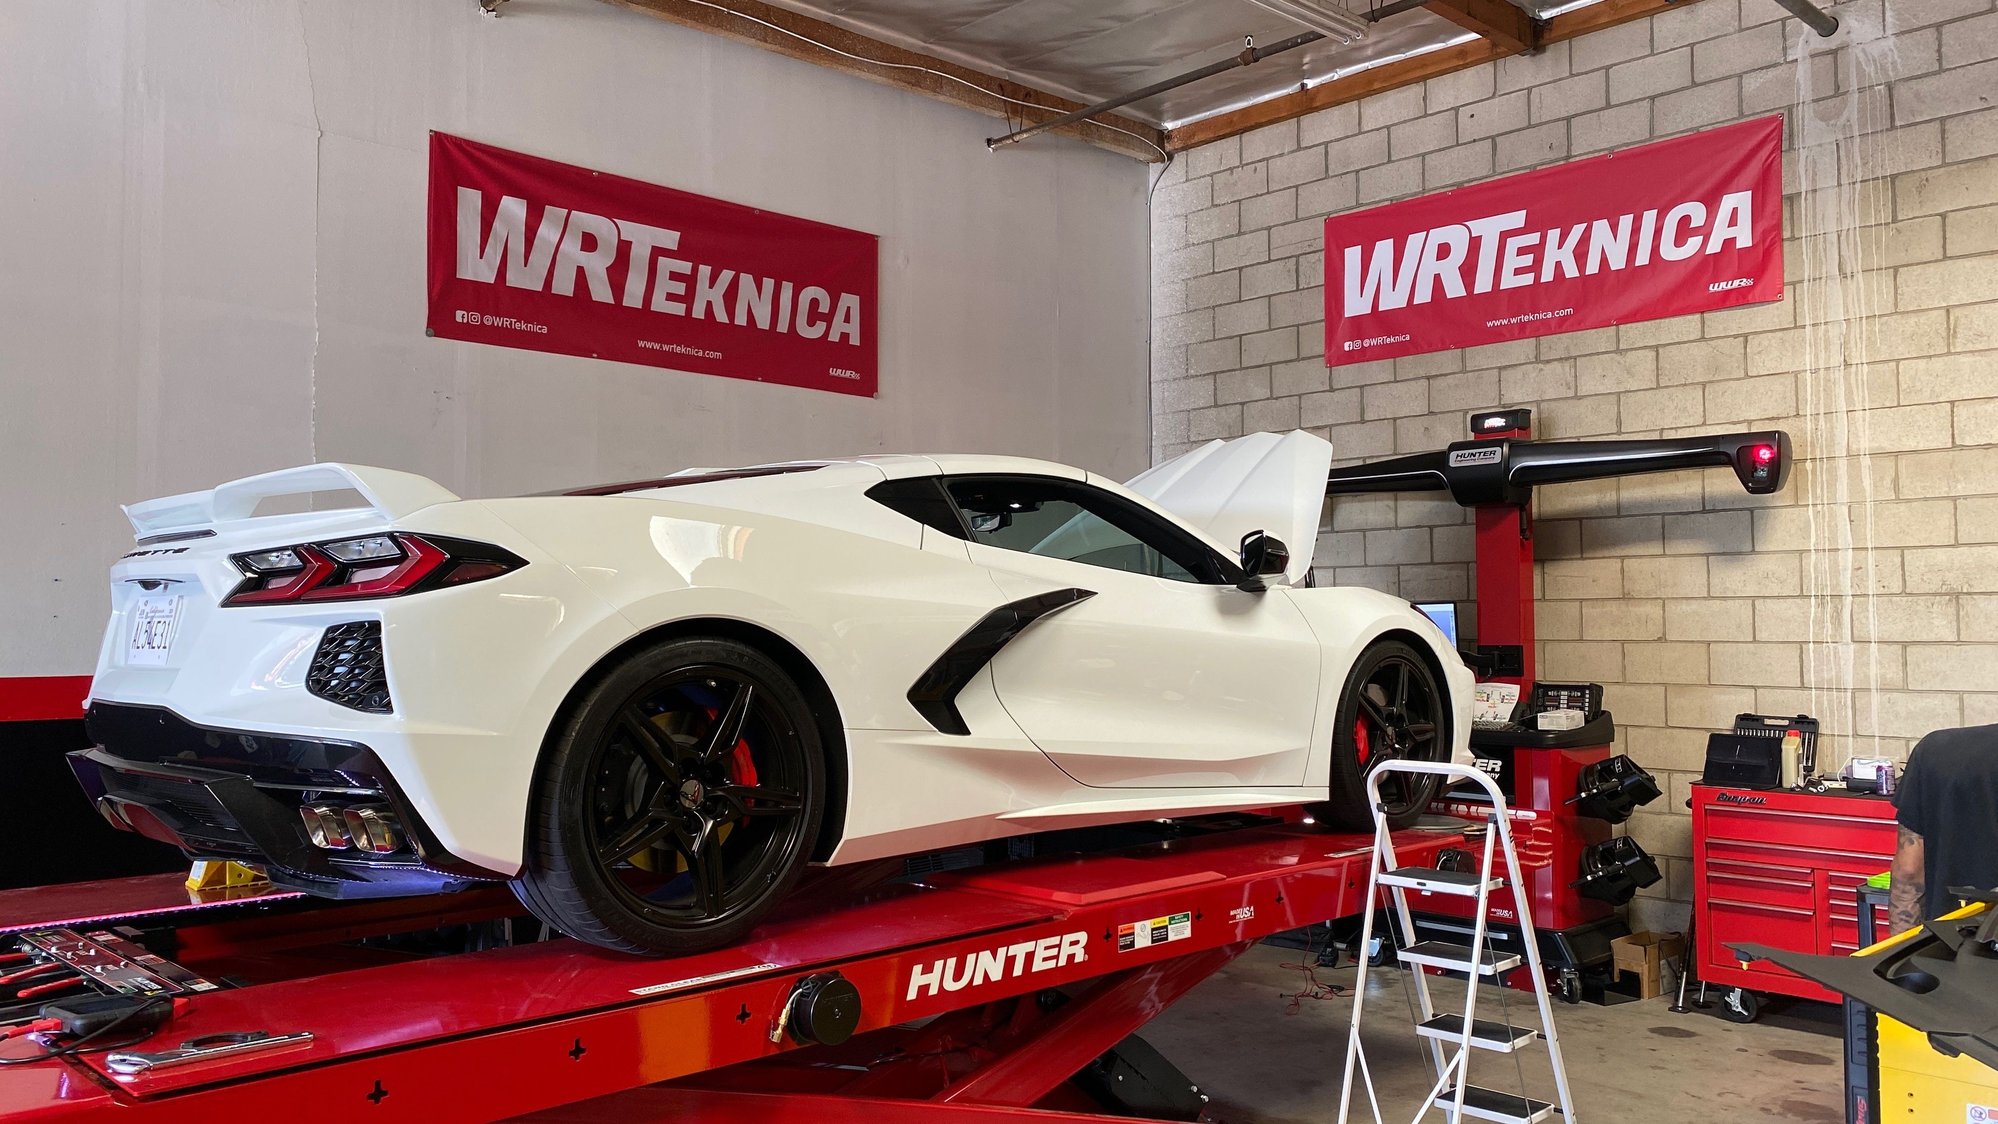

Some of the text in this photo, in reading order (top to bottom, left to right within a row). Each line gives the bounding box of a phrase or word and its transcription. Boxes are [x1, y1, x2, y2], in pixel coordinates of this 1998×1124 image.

[483, 314, 548, 334] @WRTeknica
[1486, 307, 1574, 328] www.wrteknica.com
[637, 338, 722, 359] www.wrteknica.com
[1363, 333, 1410, 348] @WRTeknica
[1455, 450, 1497, 460] HUNTER
[1240, 905, 1254, 919] USA
[905, 931, 1088, 1001] HUNTER
